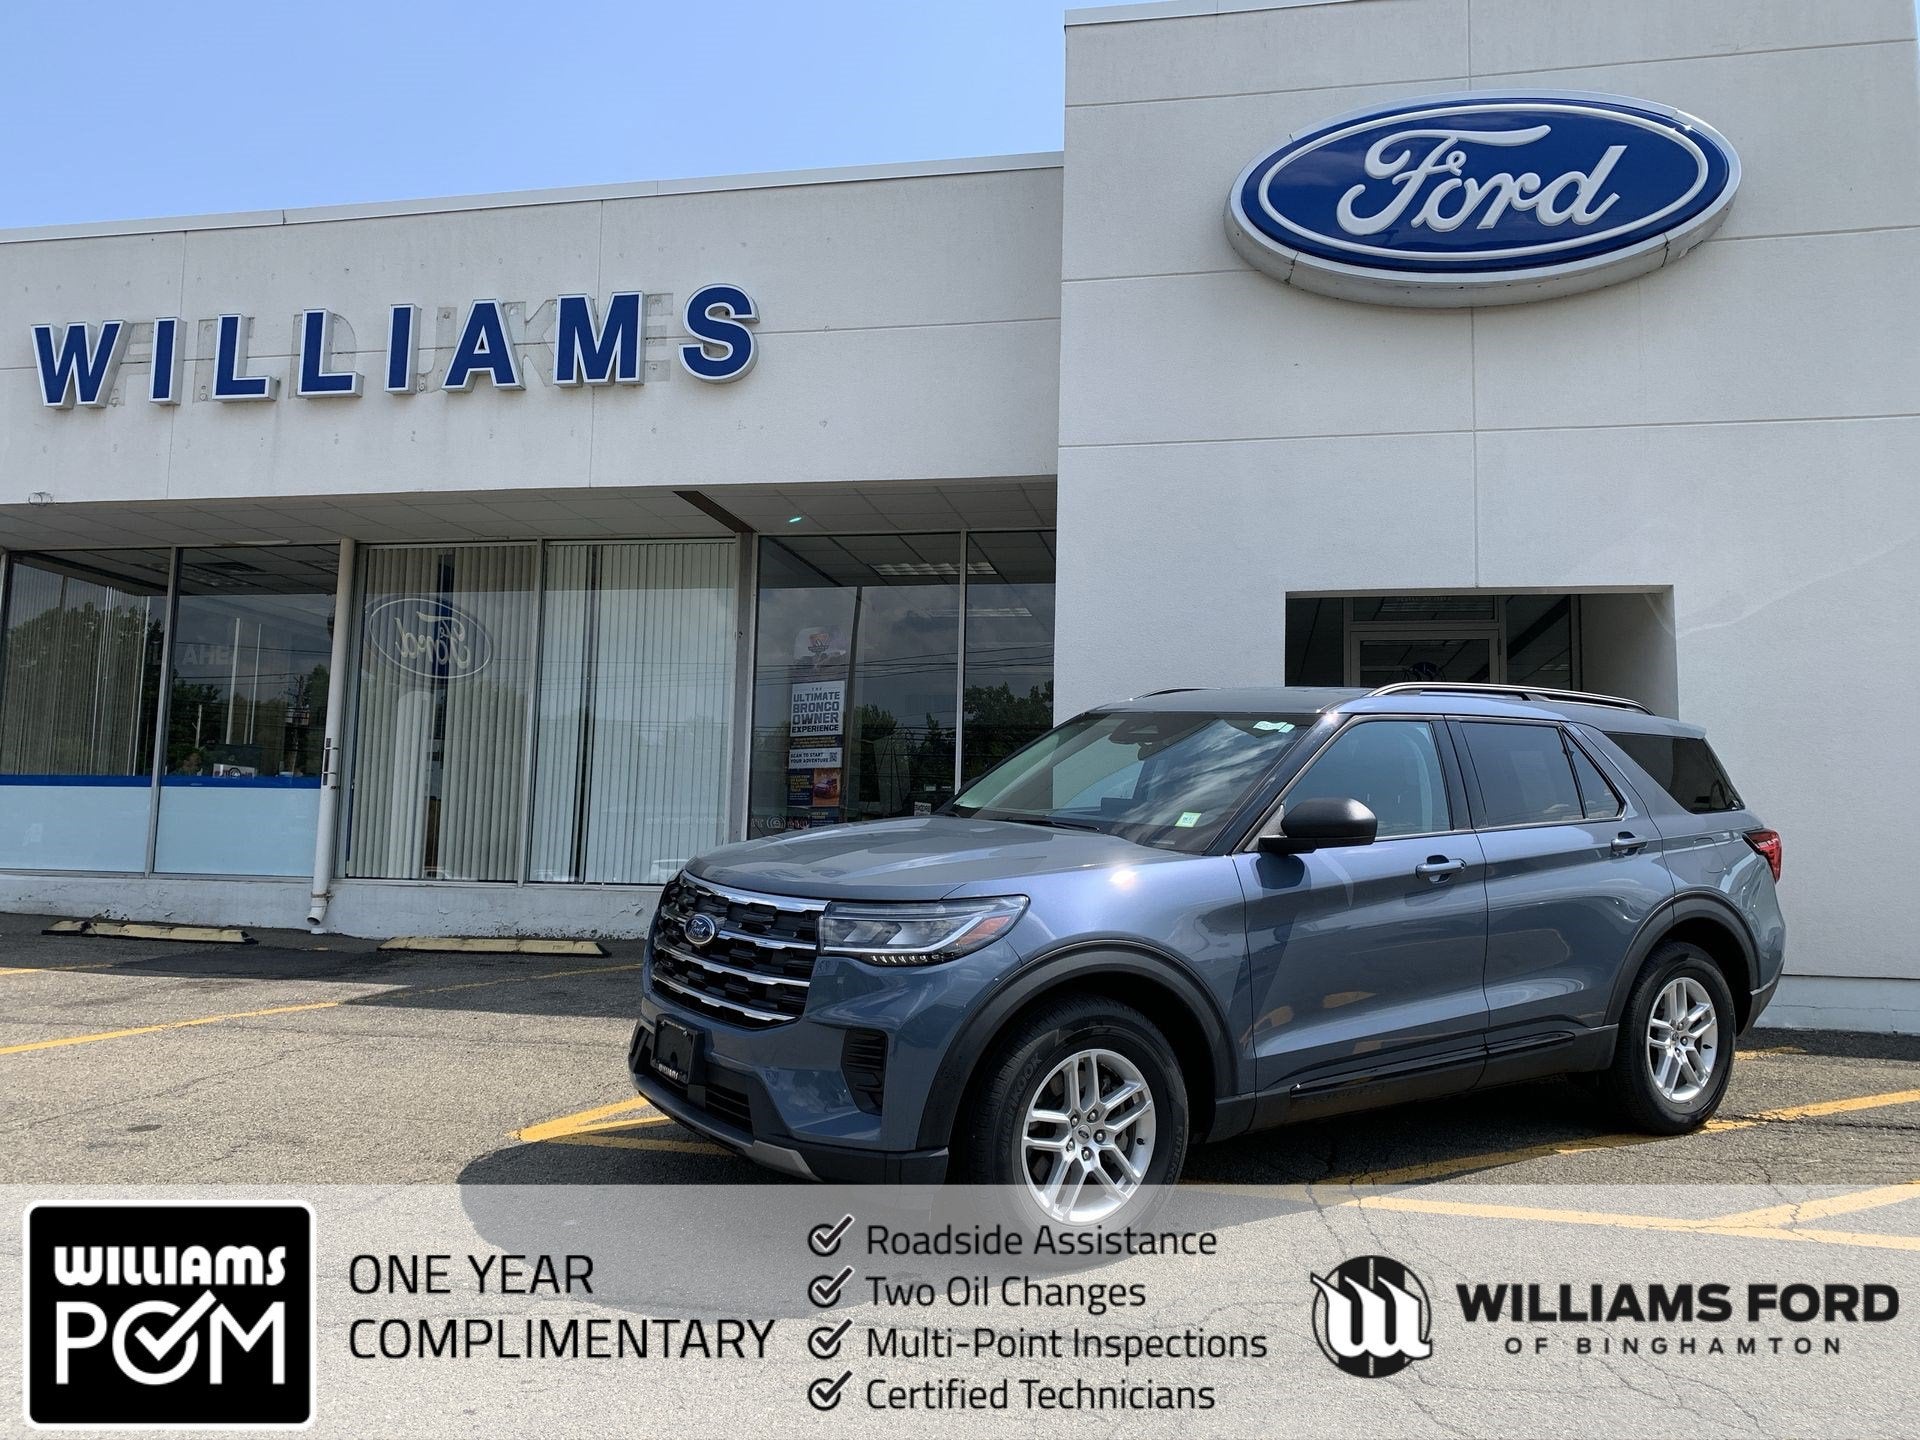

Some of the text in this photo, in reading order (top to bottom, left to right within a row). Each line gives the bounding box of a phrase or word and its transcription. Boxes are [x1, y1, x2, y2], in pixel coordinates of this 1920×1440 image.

[1336, 124, 1627, 236] Ford
[31, 283, 759, 409] WILLIAMS
[793, 691, 841, 702] ULTIMATE
[792, 701, 840, 713] BRONCO
[792, 711, 839, 725] OWNER
[791, 724, 839, 733] EXPERIENCE
